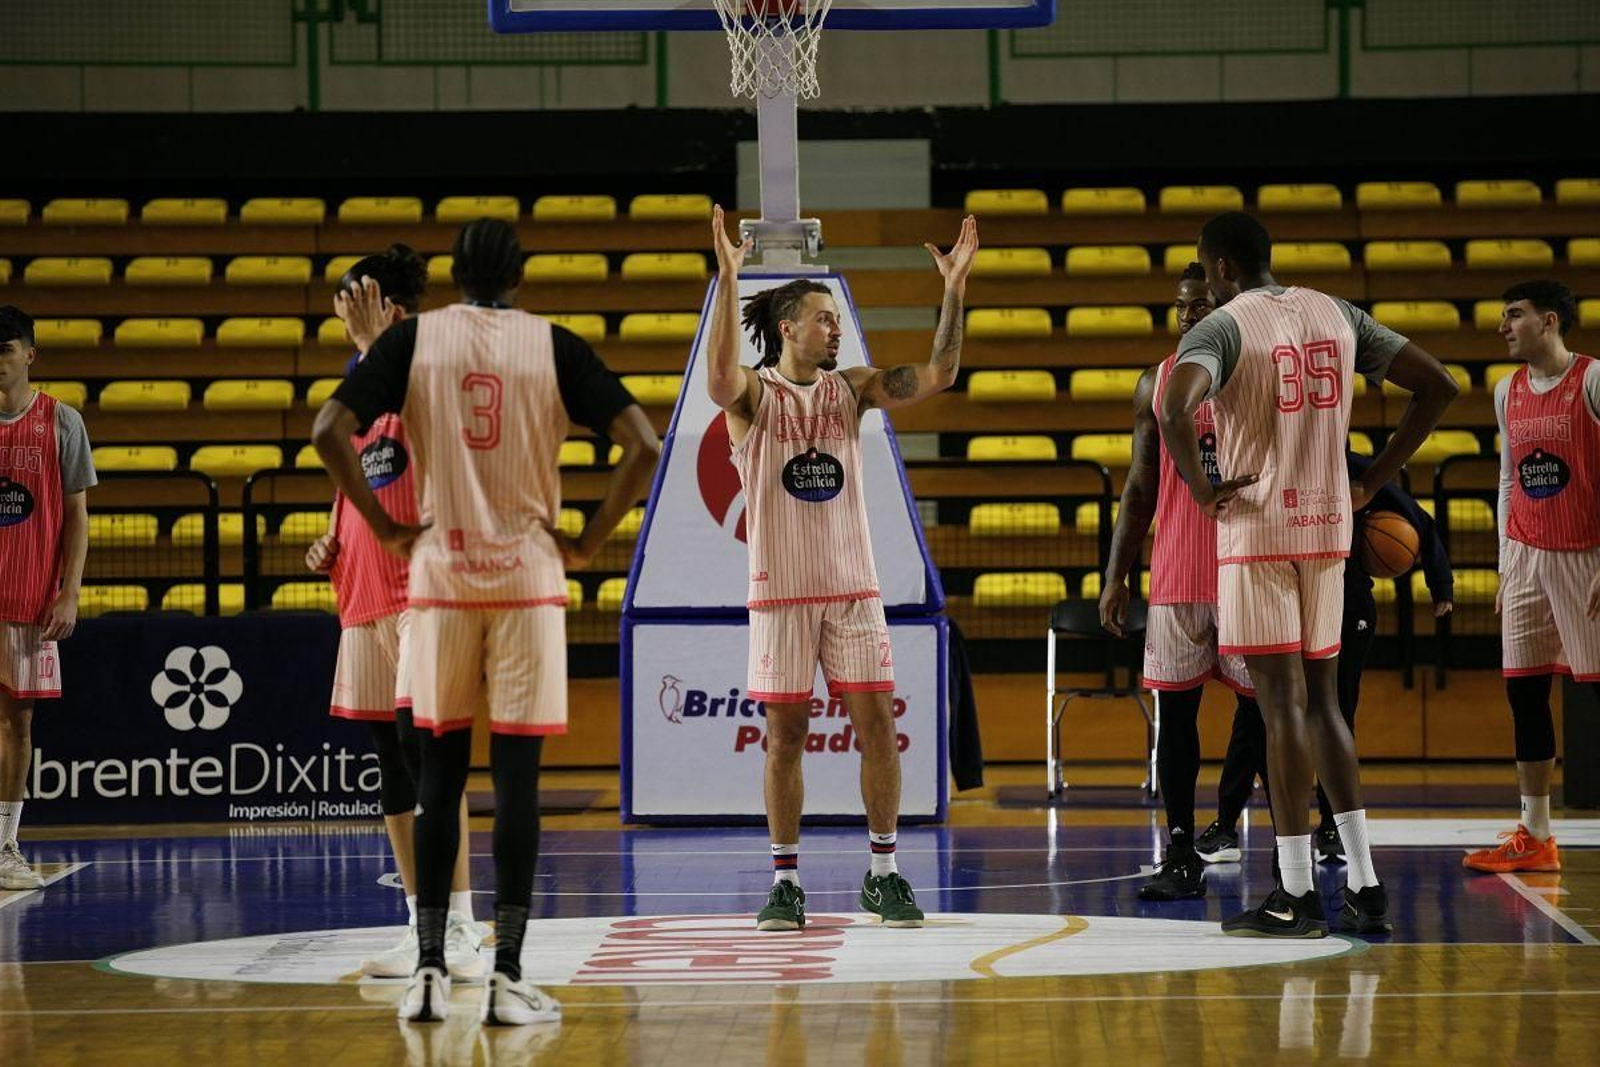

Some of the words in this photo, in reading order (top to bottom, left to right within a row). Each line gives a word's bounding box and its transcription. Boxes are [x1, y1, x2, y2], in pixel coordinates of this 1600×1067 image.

[1272, 340, 1344, 413] 35
[461, 372, 503, 450] 3
[1509, 414, 1572, 447] 32005
[792, 462, 837, 476] Estrella
[1522, 462, 1559, 475] Estrella
[794, 475, 836, 489] Galicia
[1524, 474, 1559, 487] Galicia
[229, 801, 309, 820] Impresión
